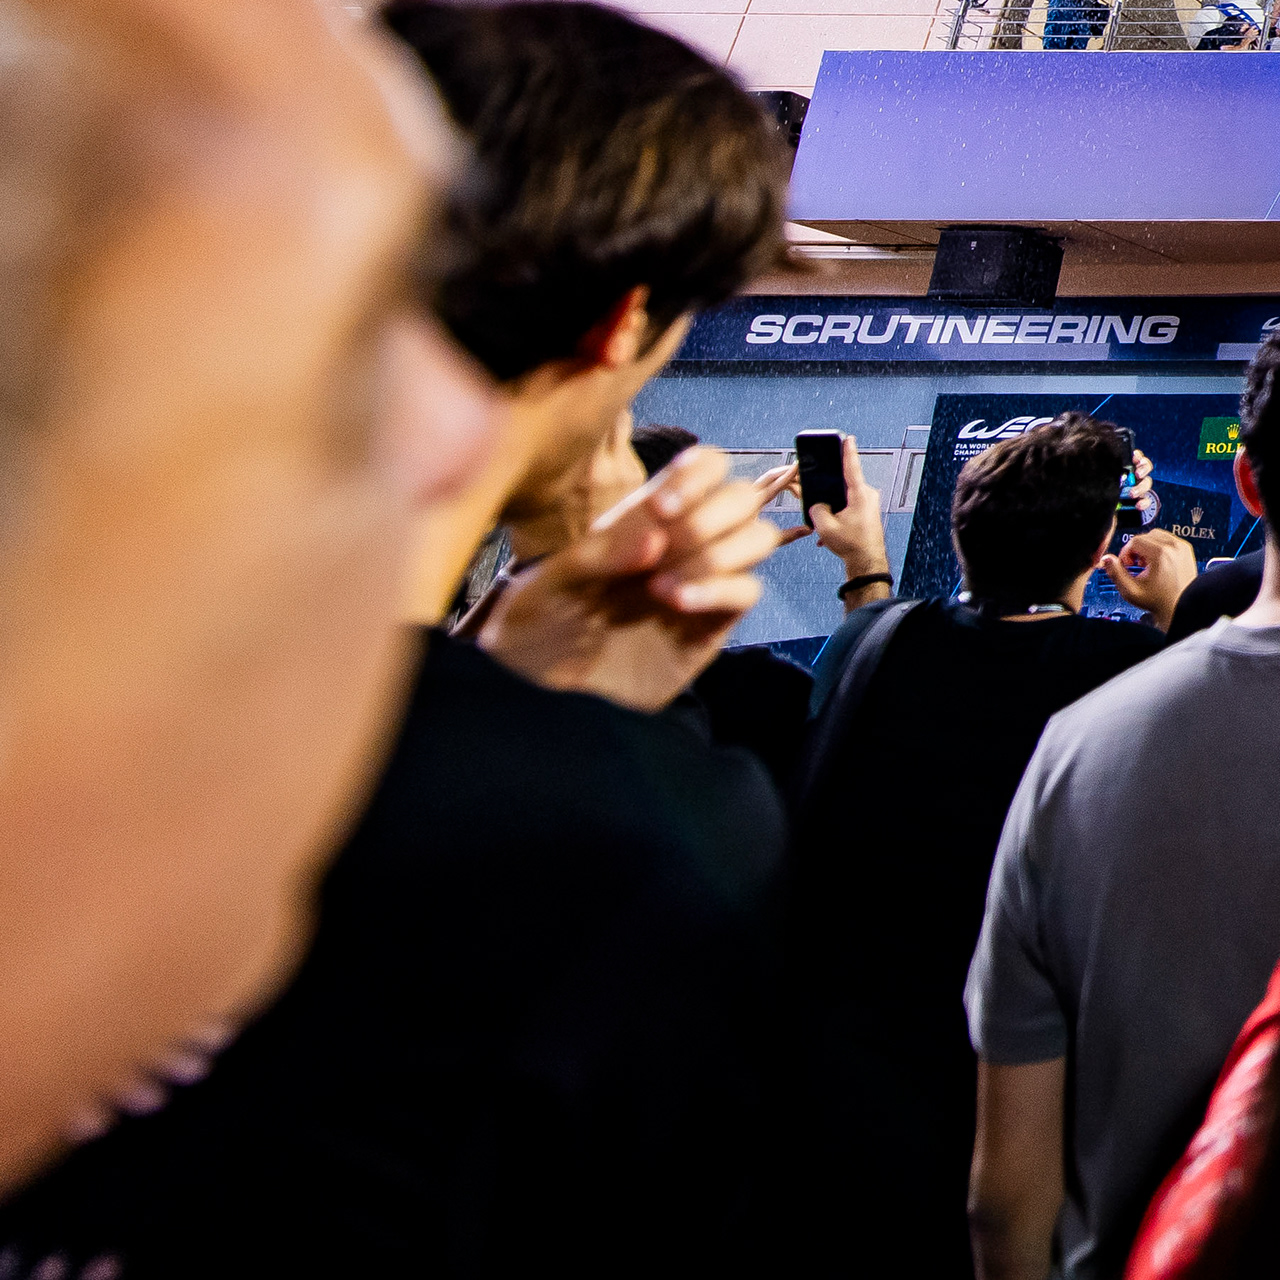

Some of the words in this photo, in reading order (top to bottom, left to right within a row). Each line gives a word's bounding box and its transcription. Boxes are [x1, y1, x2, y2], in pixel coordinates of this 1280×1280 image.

[745, 315, 1181, 345] SCRUTINEERING
[1205, 442, 1243, 454] ROL
[1171, 524, 1216, 539] ROLEX
